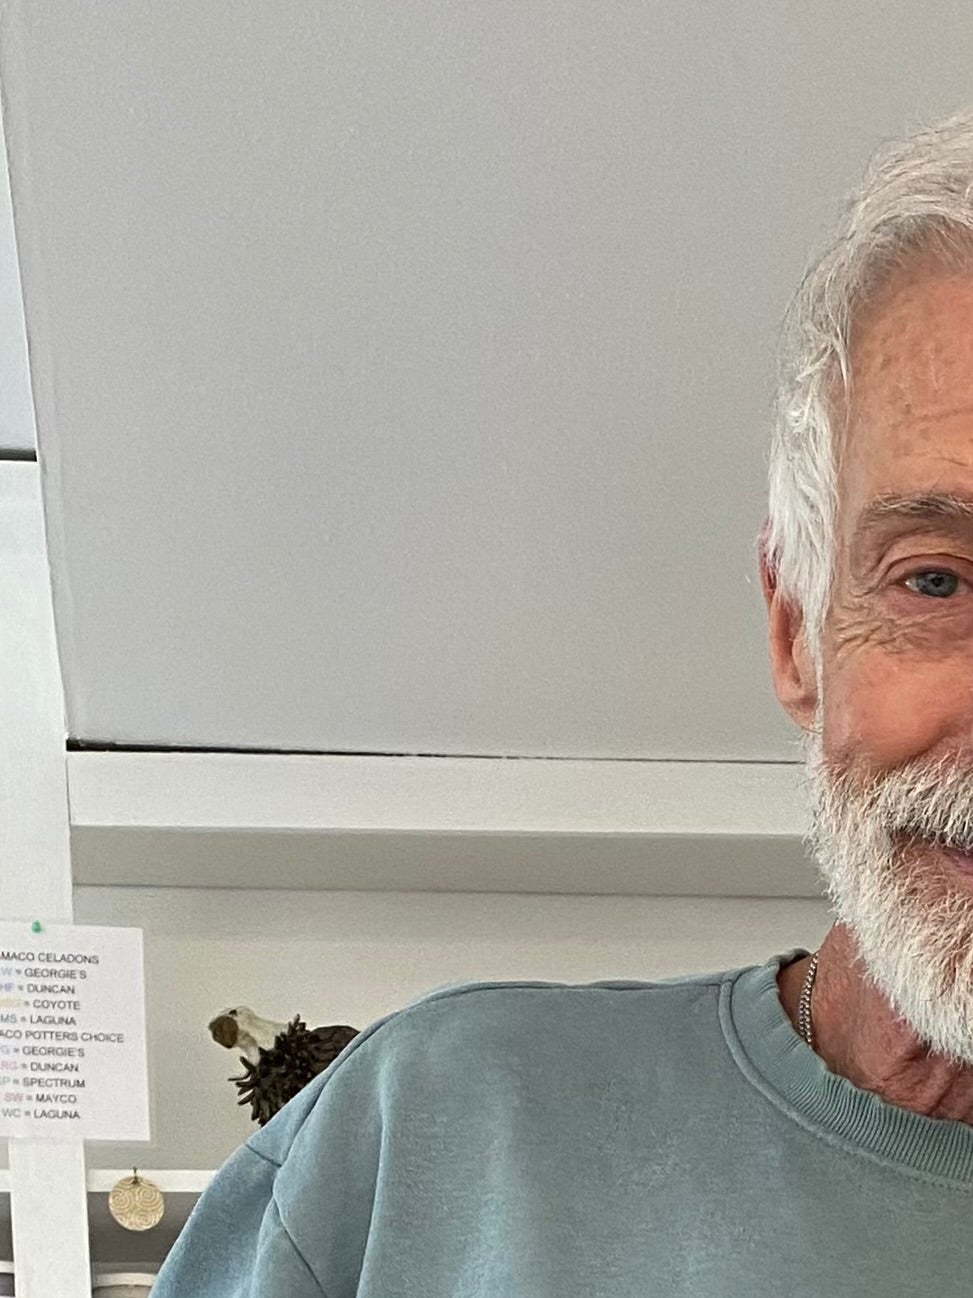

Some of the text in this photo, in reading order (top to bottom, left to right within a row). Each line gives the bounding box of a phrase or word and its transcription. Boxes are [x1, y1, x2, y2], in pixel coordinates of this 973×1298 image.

[0, 951, 99, 965] MACO CELADONS
[27, 983, 75, 994] DUNCAN
[33, 999, 80, 1011] COYOTE
[30, 1014, 77, 1026] LAGUNA
[25, 1030, 78, 1041] POTTERS
[81, 1032, 125, 1043] CHOICE
[30, 1062, 79, 1073] DUNCAN
[22, 1077, 85, 1088] SPECTRUM
[36, 1093, 77, 1104] MAYCO
[34, 1109, 80, 1120] LAGUNA
